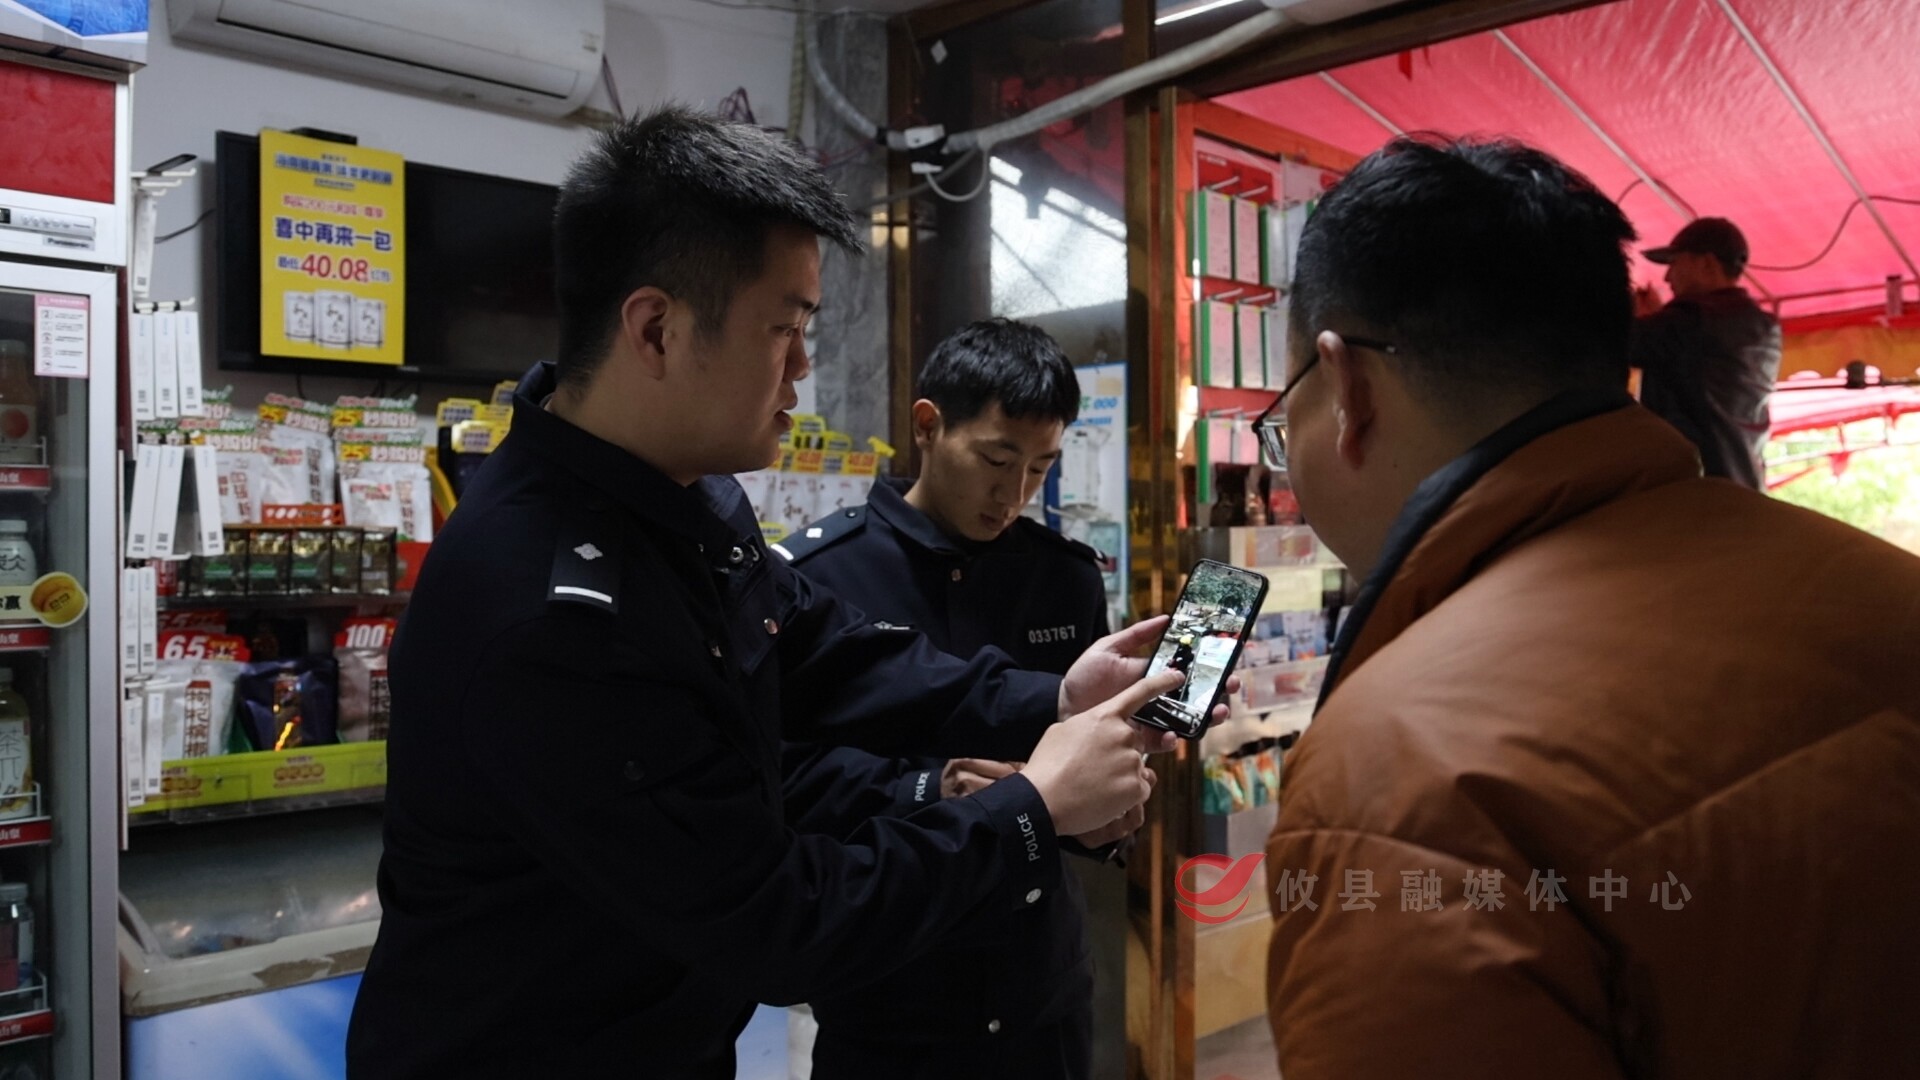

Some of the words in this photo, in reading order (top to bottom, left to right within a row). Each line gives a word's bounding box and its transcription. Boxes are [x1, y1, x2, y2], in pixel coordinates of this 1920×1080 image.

[275, 217, 392, 251] 喜中再来一包
[164, 635, 207, 660] 65
[345, 625, 386, 648] 100
[1028, 625, 1077, 644] 033767
[914, 771, 931, 802] POLICE
[1016, 812, 1041, 862] POLICE
